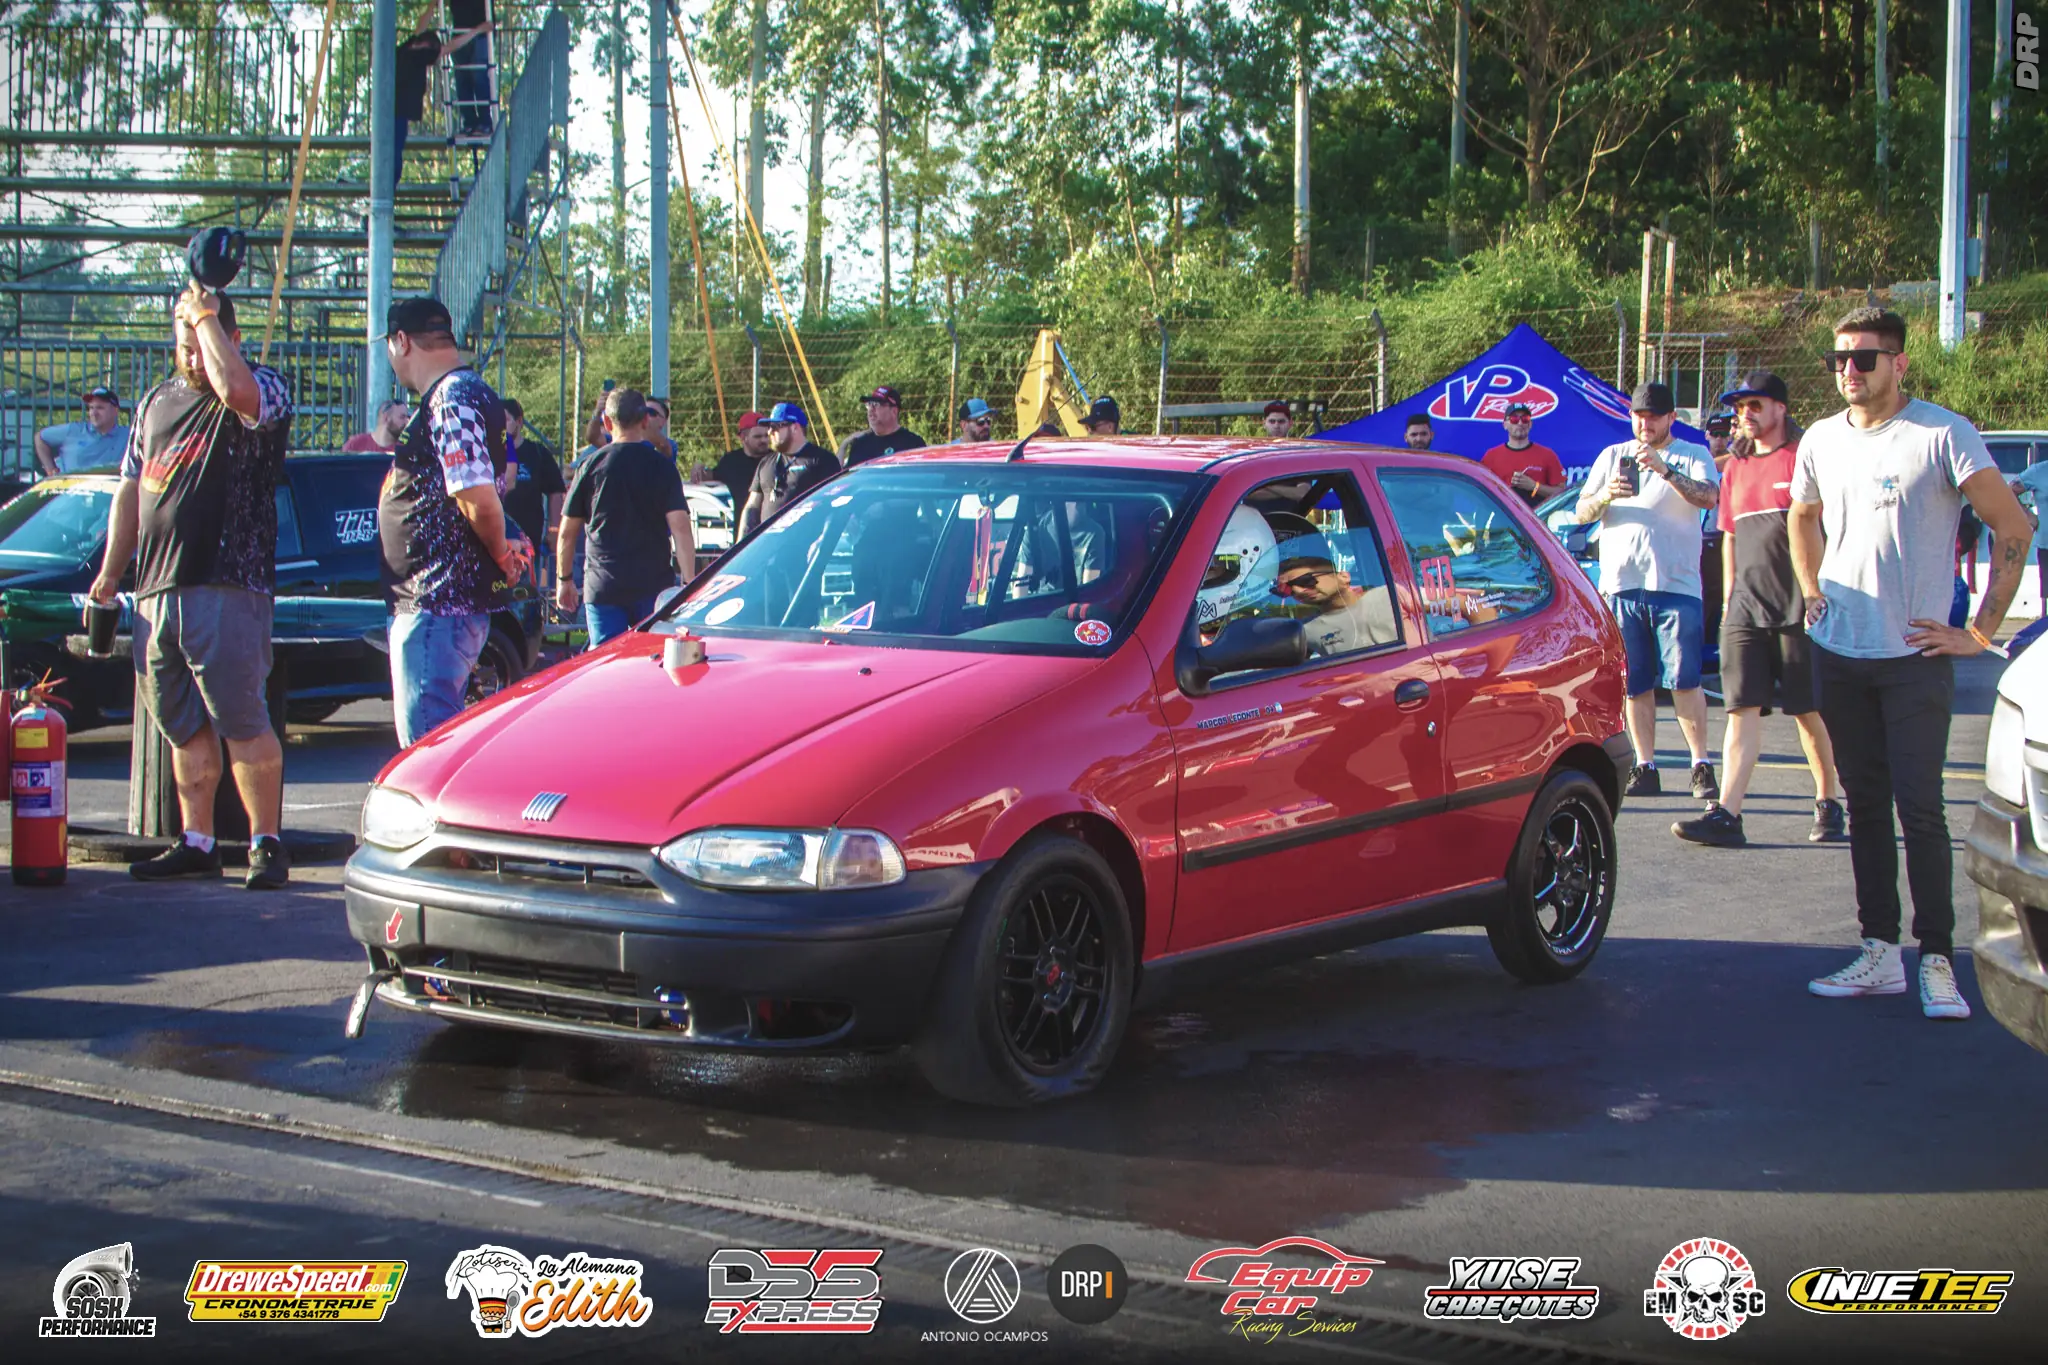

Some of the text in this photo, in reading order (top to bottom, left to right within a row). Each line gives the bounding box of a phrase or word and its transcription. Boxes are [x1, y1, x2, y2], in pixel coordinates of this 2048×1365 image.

[1446, 364, 1530, 420] VP
[335, 508, 378, 536] 779
[1420, 556, 1455, 600] 673
